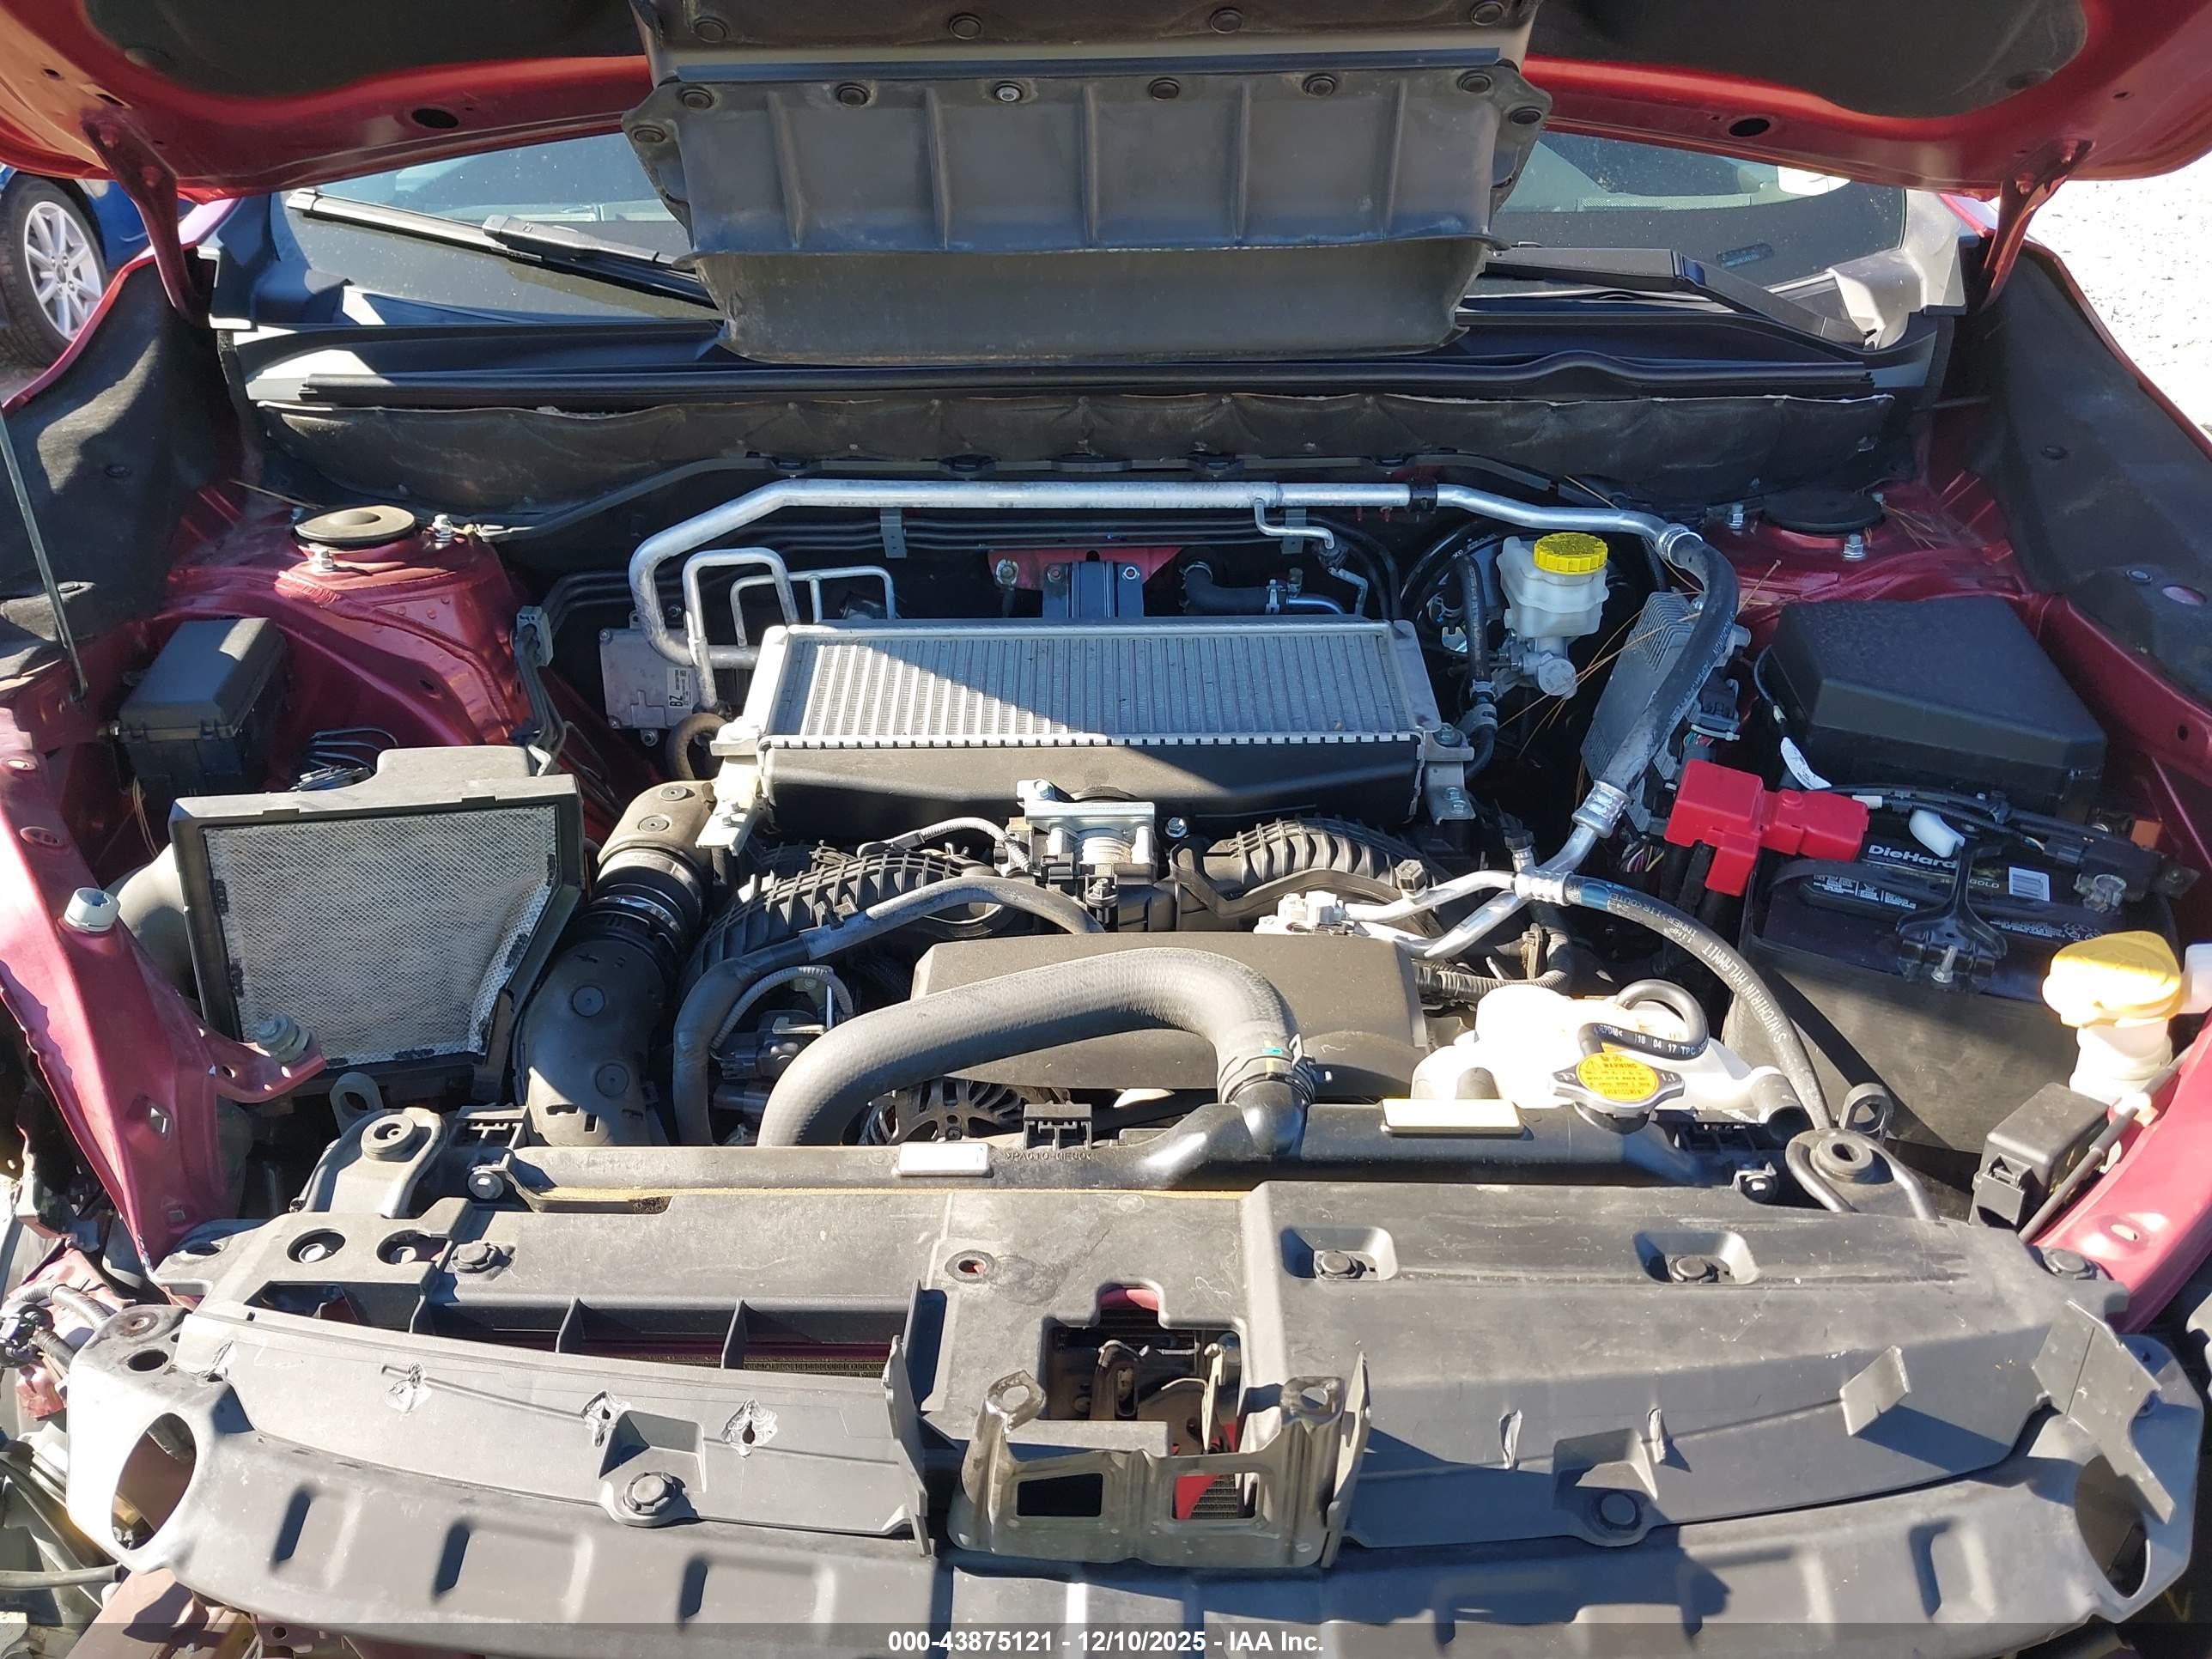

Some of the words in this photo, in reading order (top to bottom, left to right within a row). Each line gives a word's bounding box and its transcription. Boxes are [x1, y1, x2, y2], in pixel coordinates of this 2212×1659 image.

[1868, 844, 1958, 870] DieHard
[1702, 941, 1749, 987] HYLAMMIT
[1653, 1040, 1662, 1049] 04
[1668, 1043, 1677, 1053] 17
[1680, 1046, 1696, 1055] TPC
